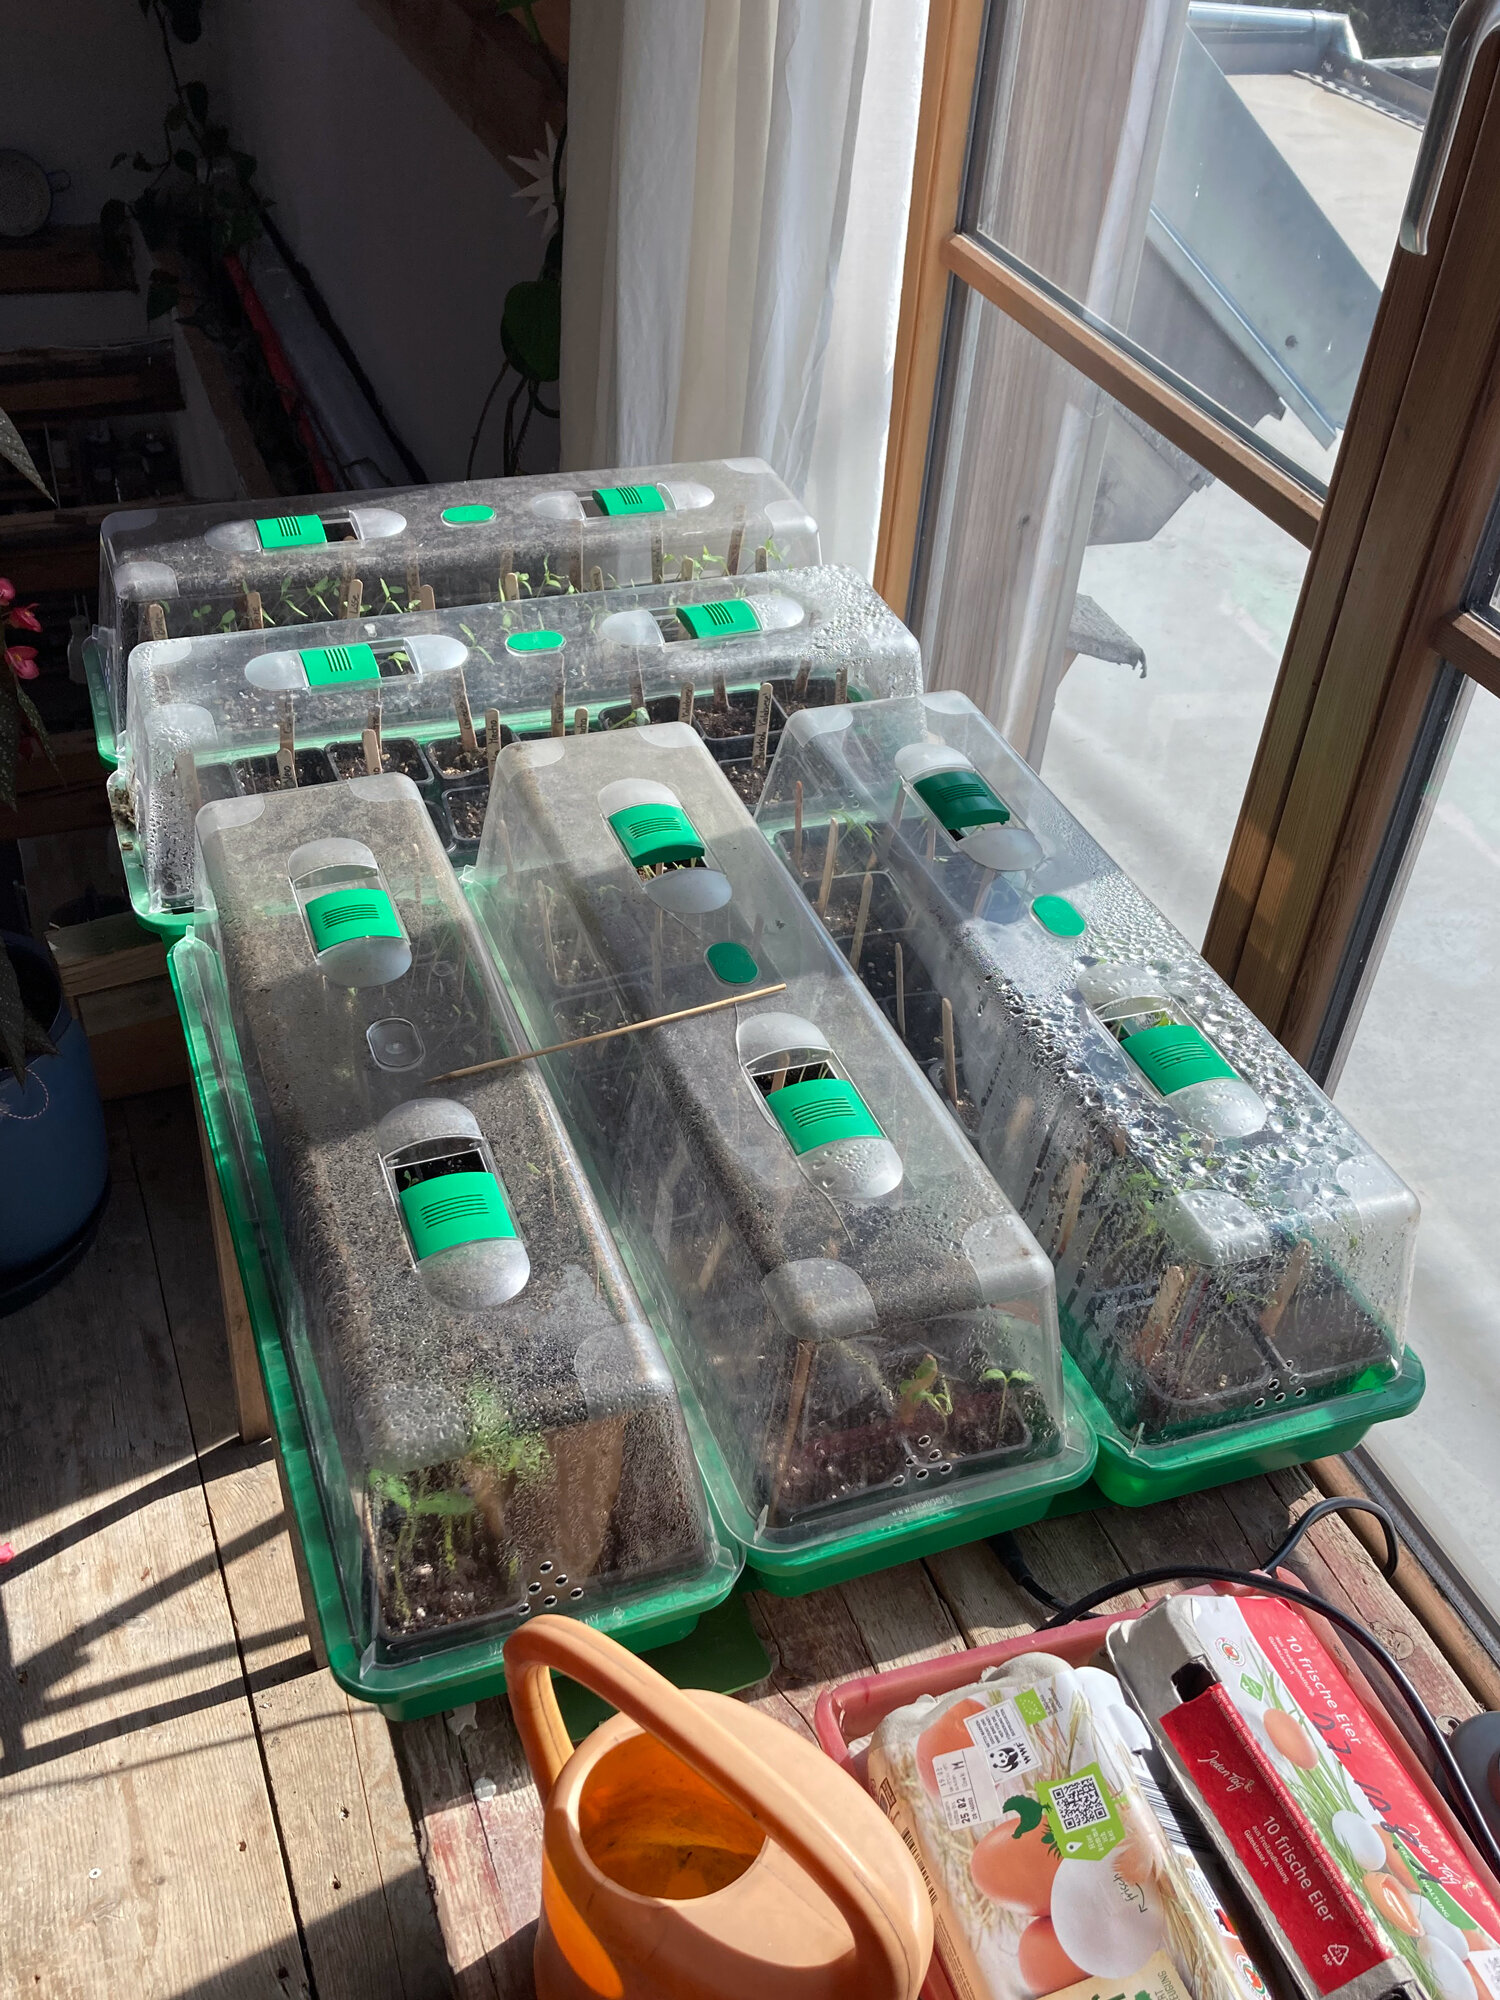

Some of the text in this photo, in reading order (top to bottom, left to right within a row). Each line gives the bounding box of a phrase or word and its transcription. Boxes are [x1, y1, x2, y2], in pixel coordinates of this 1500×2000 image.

[1285, 1635, 1362, 1744] 10 frische Eier
[1015, 1742, 1031, 1764] WWF
[1195, 1750, 1245, 1792] Jeden Tag
[954, 1796, 971, 1824] 25.02
[1242, 1828, 1270, 1868] Güteklasse A
[1250, 1824, 1290, 1885] aus Freilandhaltung,
[1262, 1814, 1334, 1924] 10 frische Eier
[1437, 1862, 1462, 1884] Tag
[1112, 1872, 1138, 1902] frisch
[1320, 1952, 1333, 1968] PAP
